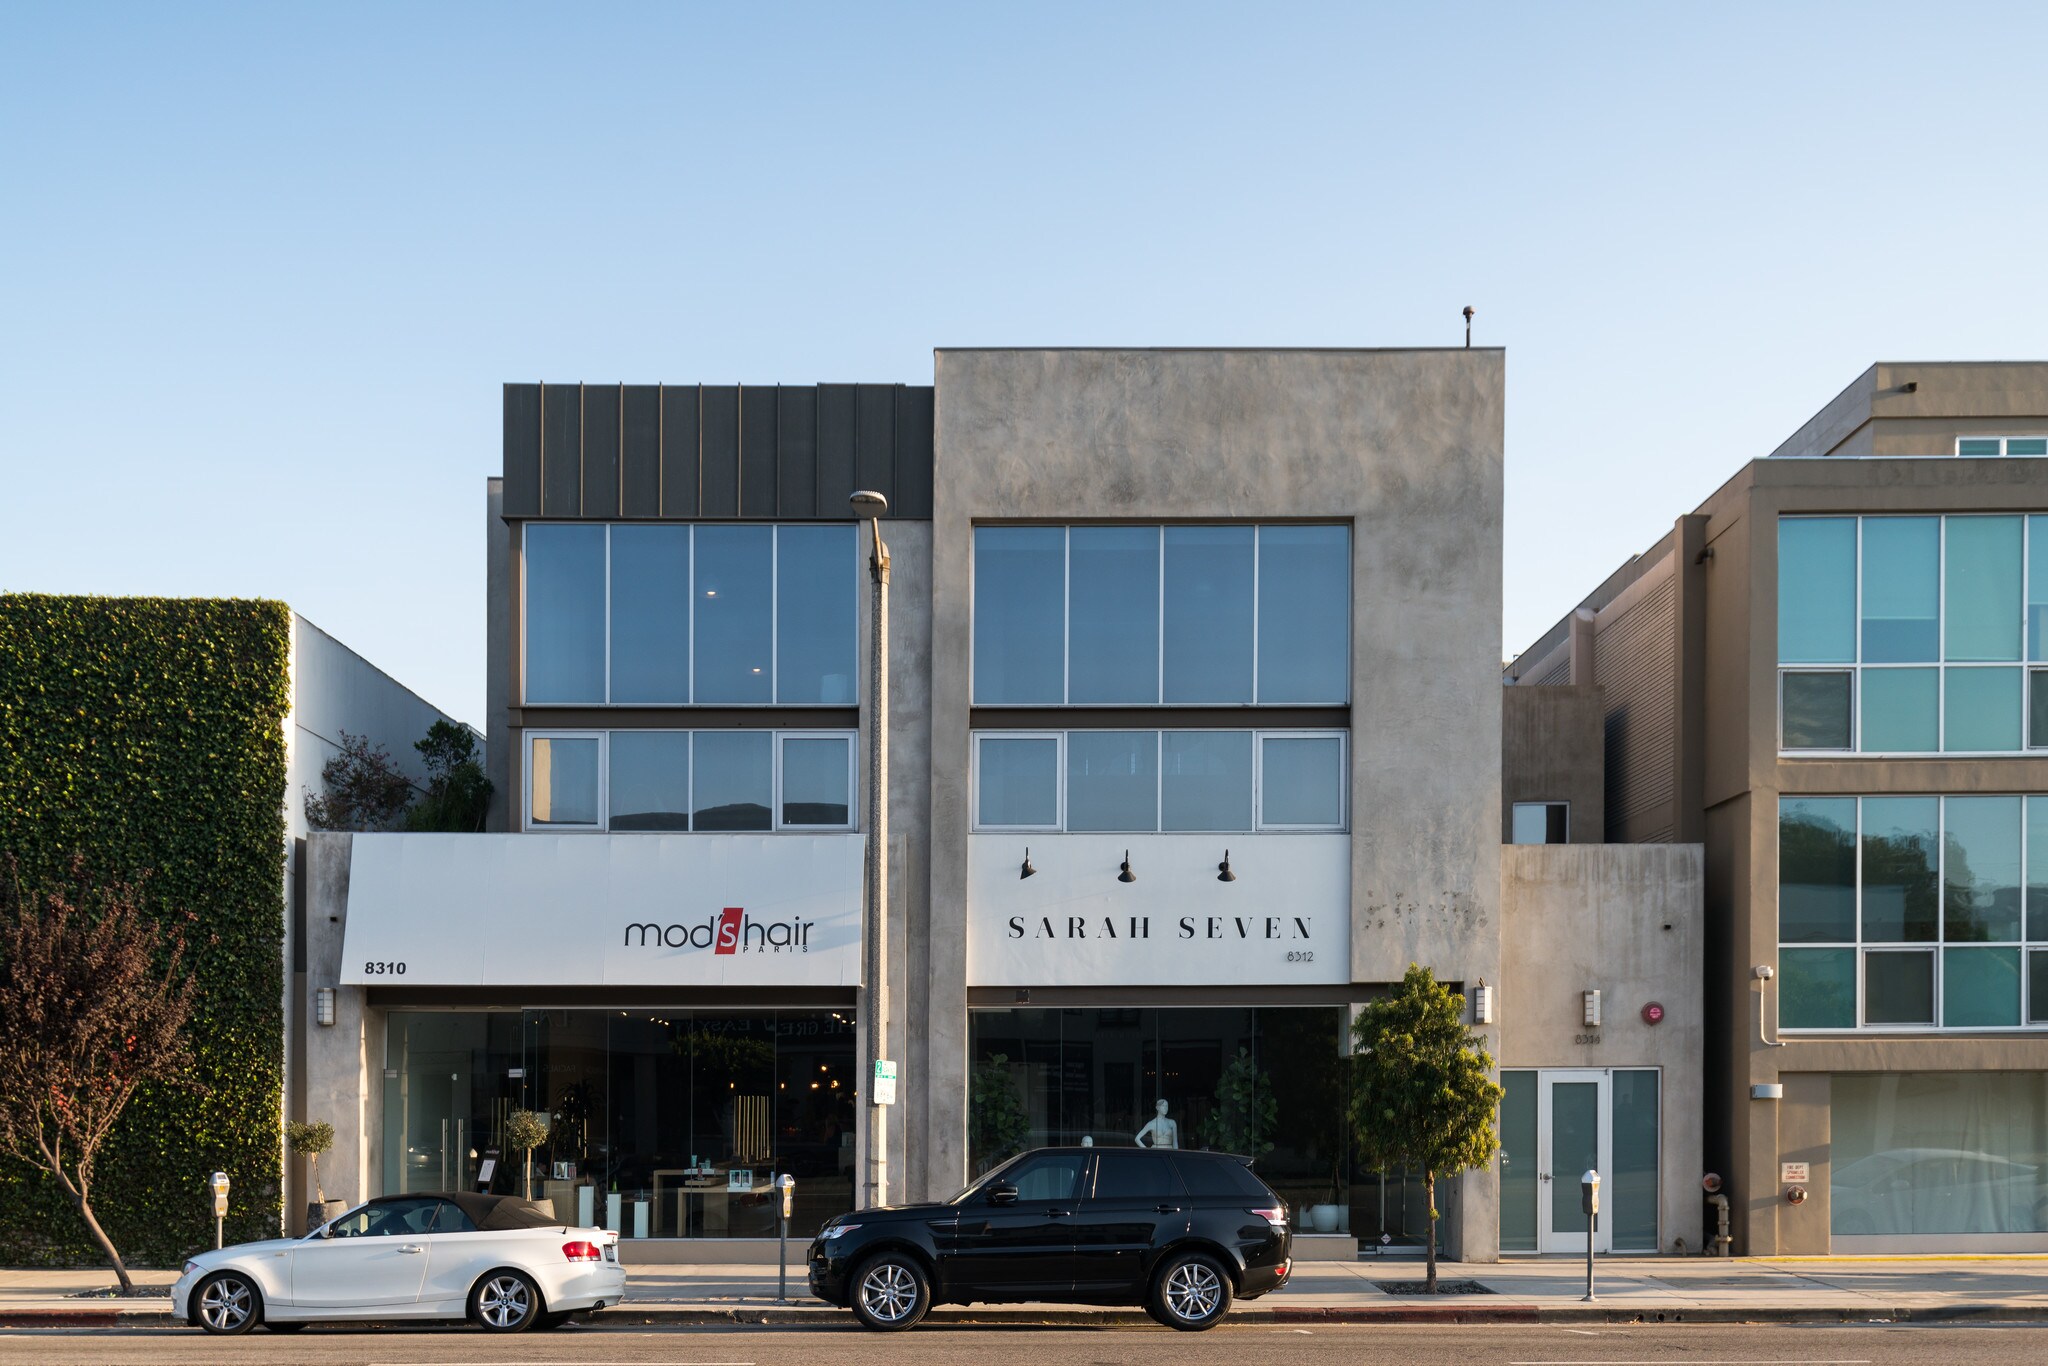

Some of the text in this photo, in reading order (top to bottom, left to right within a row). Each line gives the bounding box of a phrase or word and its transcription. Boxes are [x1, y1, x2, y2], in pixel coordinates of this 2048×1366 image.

[1008, 916, 1312, 939] SARAH SEVEN
[743, 945, 808, 953] PARIS
[1286, 950, 1314, 962] 8312
[364, 961, 407, 975] 8310
